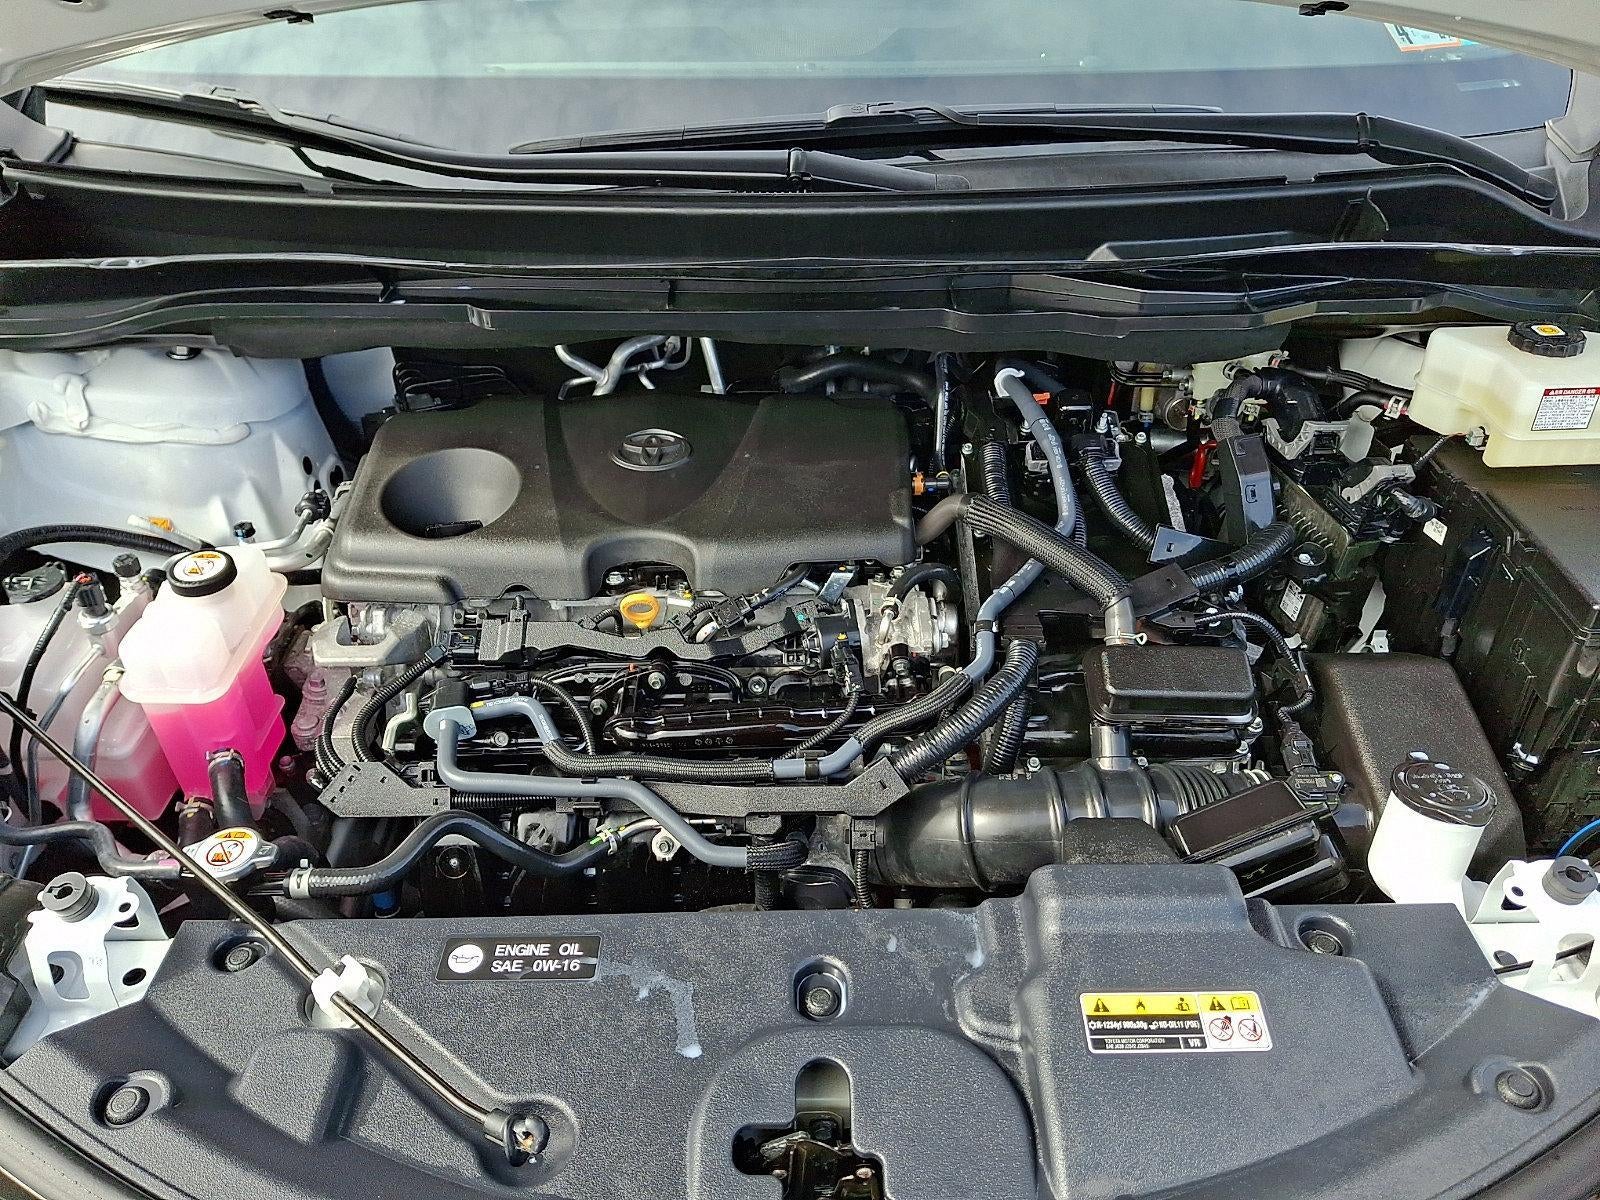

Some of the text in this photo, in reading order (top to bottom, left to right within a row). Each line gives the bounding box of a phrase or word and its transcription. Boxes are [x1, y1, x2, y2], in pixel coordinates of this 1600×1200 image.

[494, 943, 584, 956] ENGINE OIL
[490, 959, 581, 972] SAE 0W-16
